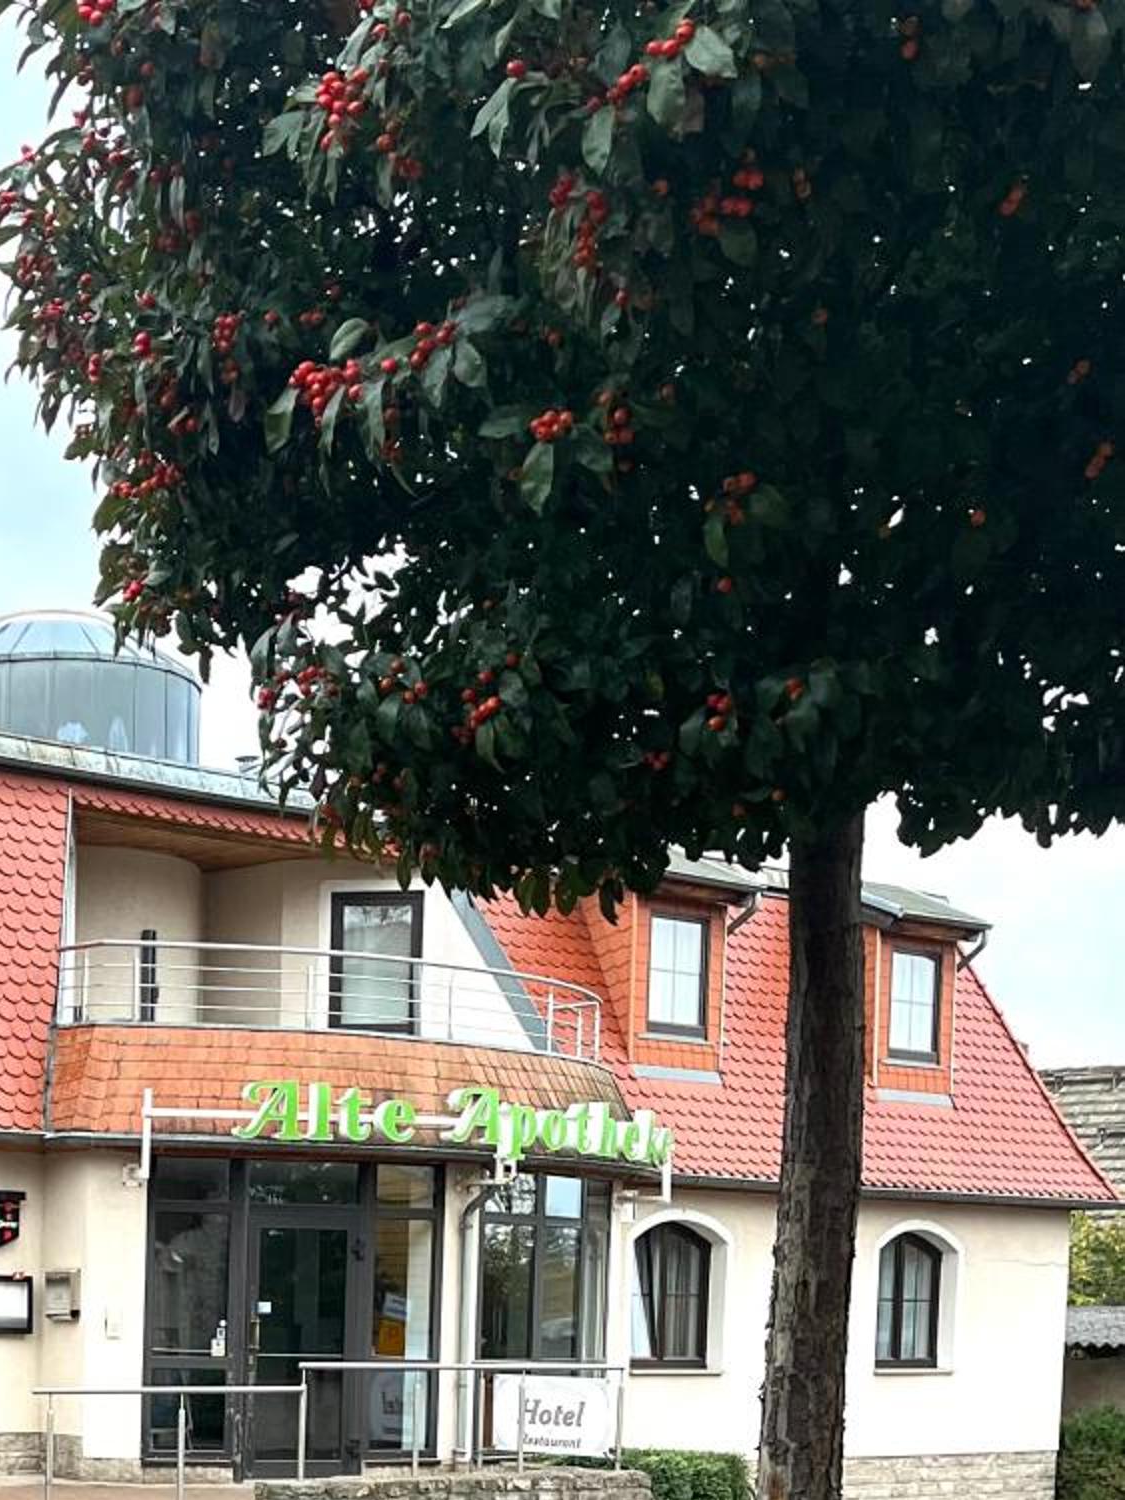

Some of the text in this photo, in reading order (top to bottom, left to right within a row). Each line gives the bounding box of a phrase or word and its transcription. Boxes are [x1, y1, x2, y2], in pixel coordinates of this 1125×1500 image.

[231, 1079, 673, 1166] Alte Apotheke
[518, 1398, 586, 1428] Hotel
